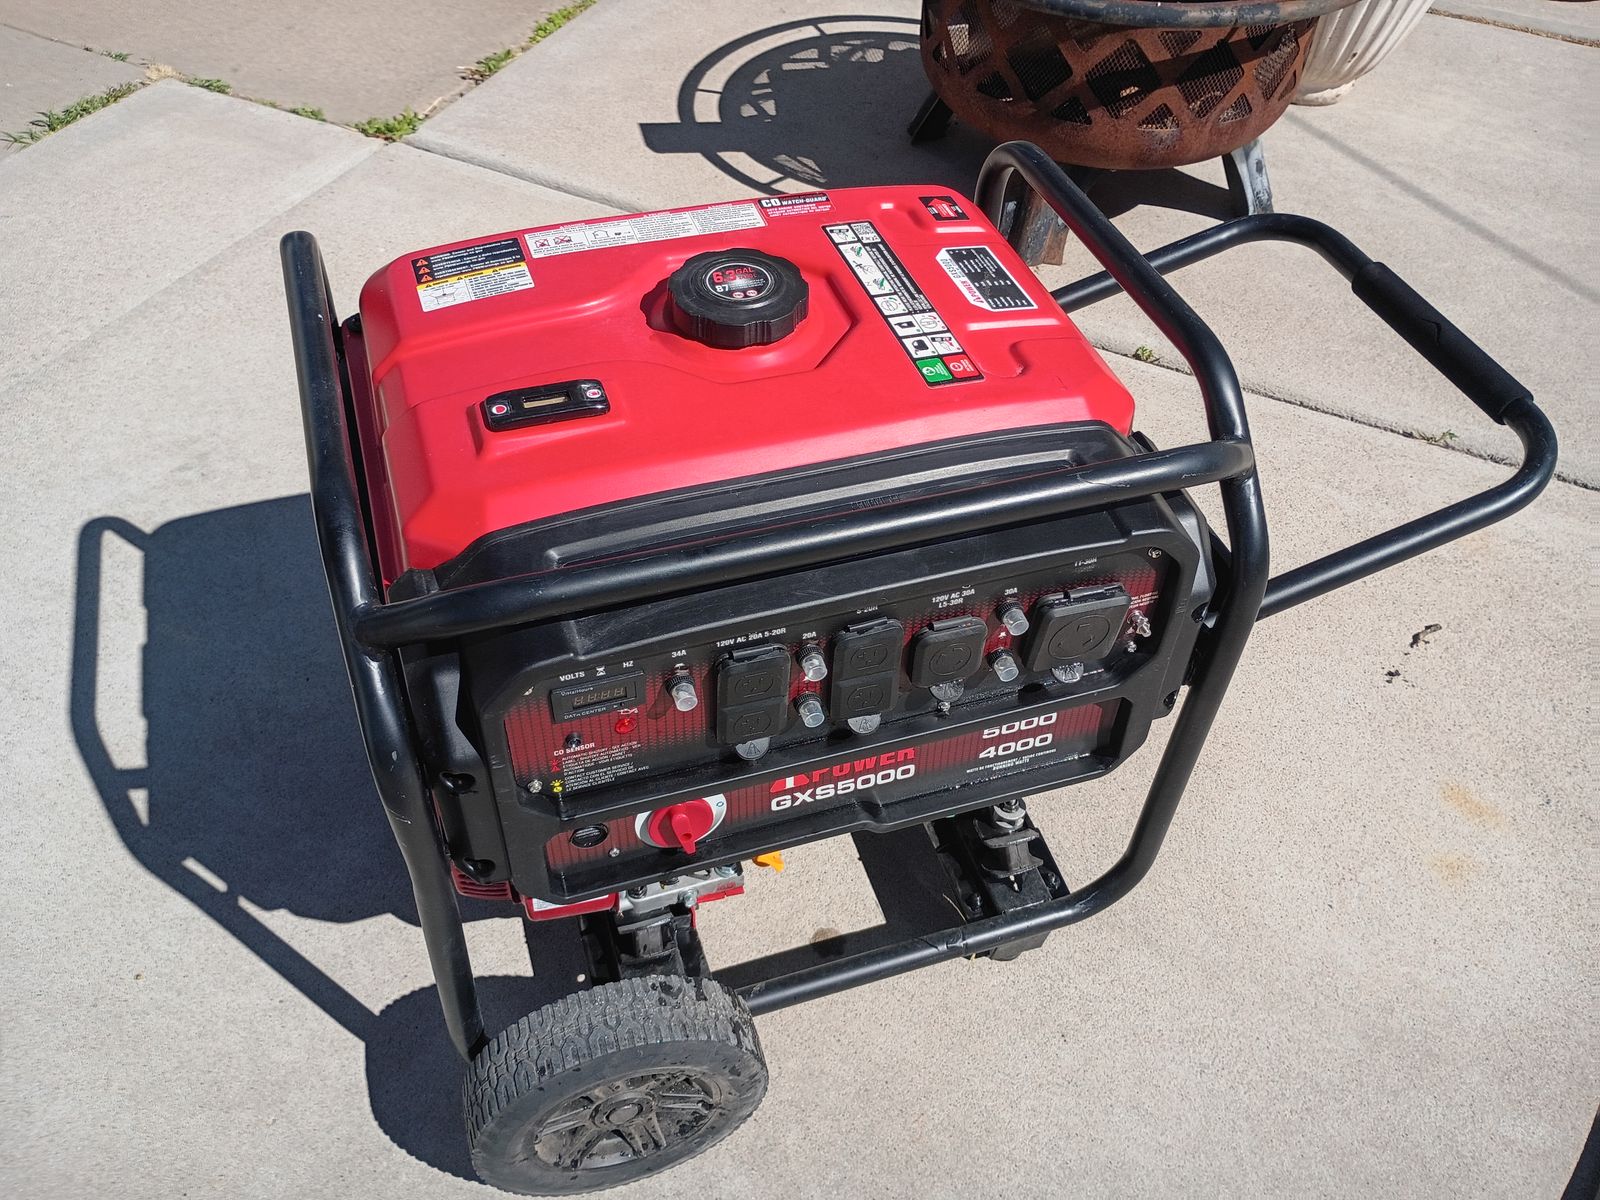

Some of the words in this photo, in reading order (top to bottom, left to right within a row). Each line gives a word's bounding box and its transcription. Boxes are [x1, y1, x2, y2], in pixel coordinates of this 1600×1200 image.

[761, 198, 781, 208] CO
[712, 269, 737, 283] 6.3
[715, 284, 729, 292] 87
[932, 593, 949, 604] 120V
[950, 591, 961, 600] AC
[1004, 587, 1018, 596] 30A
[716, 638, 734, 648] 120V
[736, 635, 747, 643] AC
[748, 632, 763, 641] 20A
[764, 627, 787, 638] 5-20R
[802, 631, 817, 640] 20A
[671, 649, 687, 658] 34A
[622, 660, 634, 669] HZ
[559, 671, 586, 682] VOLTS
[564, 711, 580, 720] DATA
[582, 706, 607, 716] CENTER
[982, 712, 1057, 739] 5000
[553, 749, 564, 757] CO
[565, 742, 595, 754] SENSOR
[978, 733, 1053, 759] 4000
[770, 764, 916, 811] GXS5000
